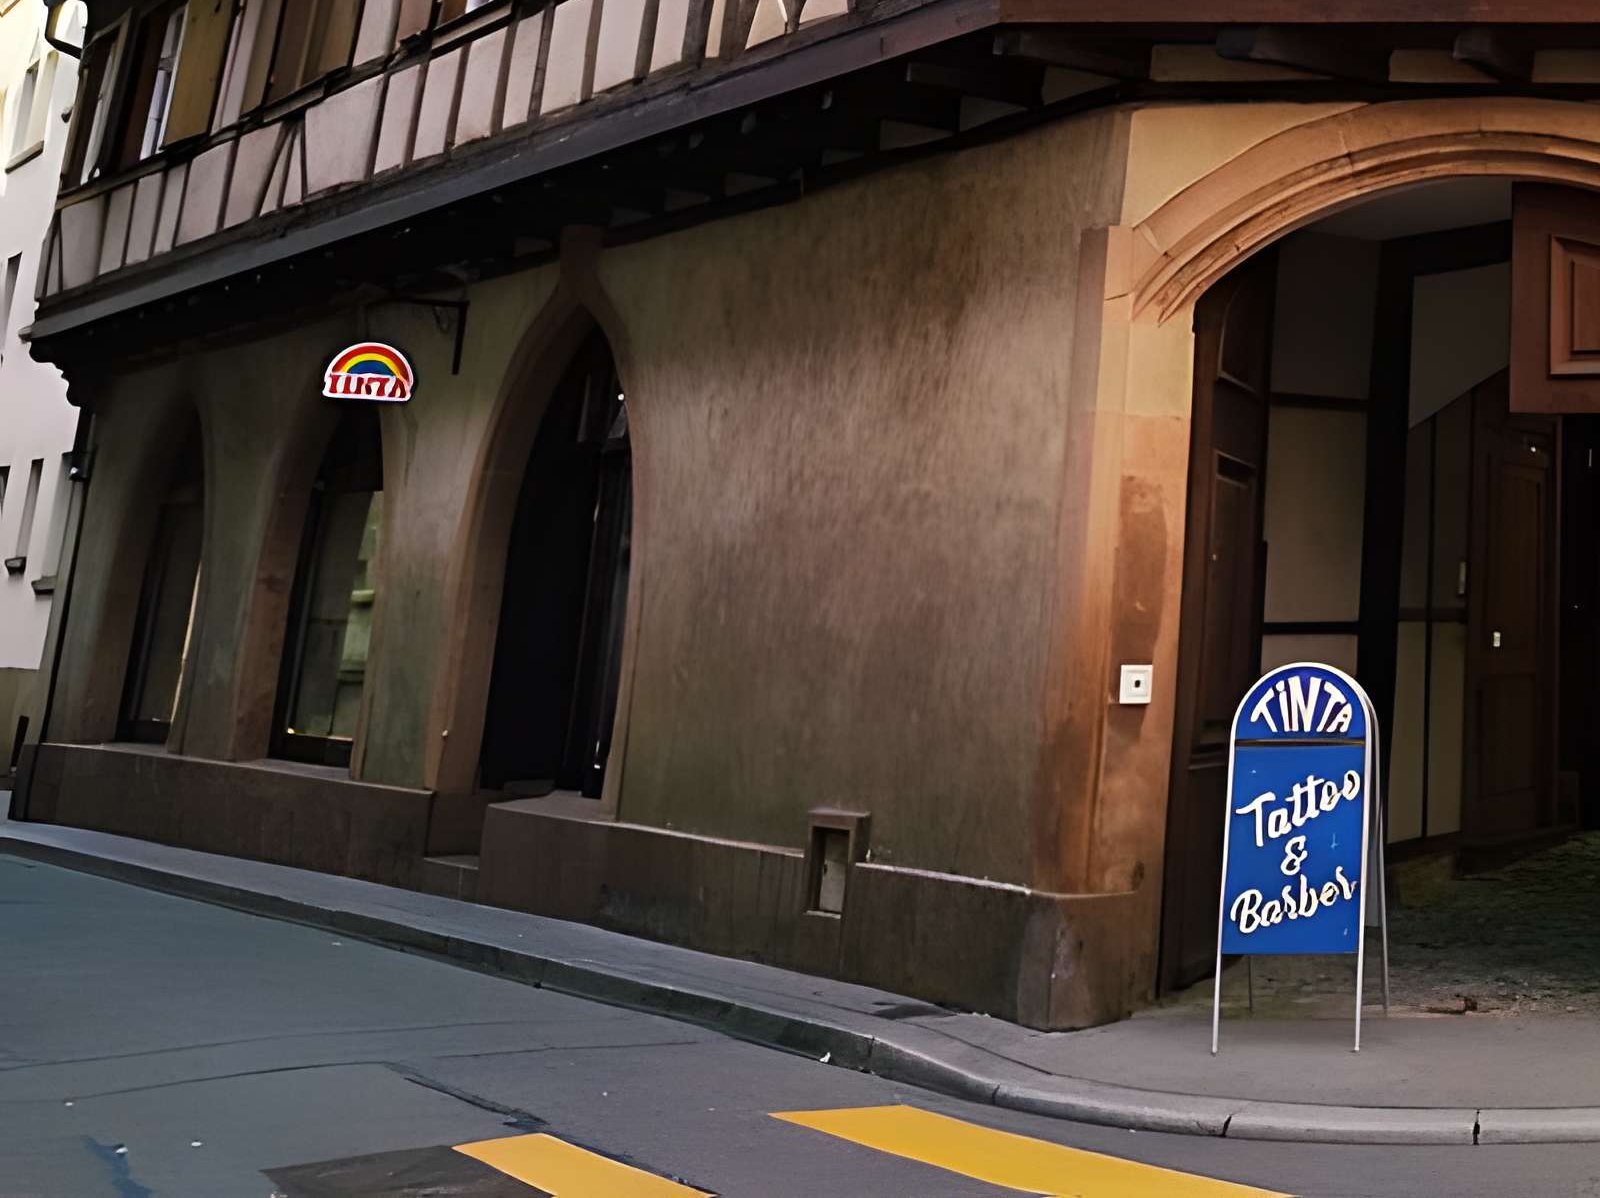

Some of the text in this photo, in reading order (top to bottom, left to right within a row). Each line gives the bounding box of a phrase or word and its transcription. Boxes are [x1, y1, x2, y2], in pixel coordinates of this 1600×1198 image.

[1235, 770, 1361, 847] Tattoo
[1280, 835, 1308, 876] &
[1230, 866, 1358, 934] Barber
